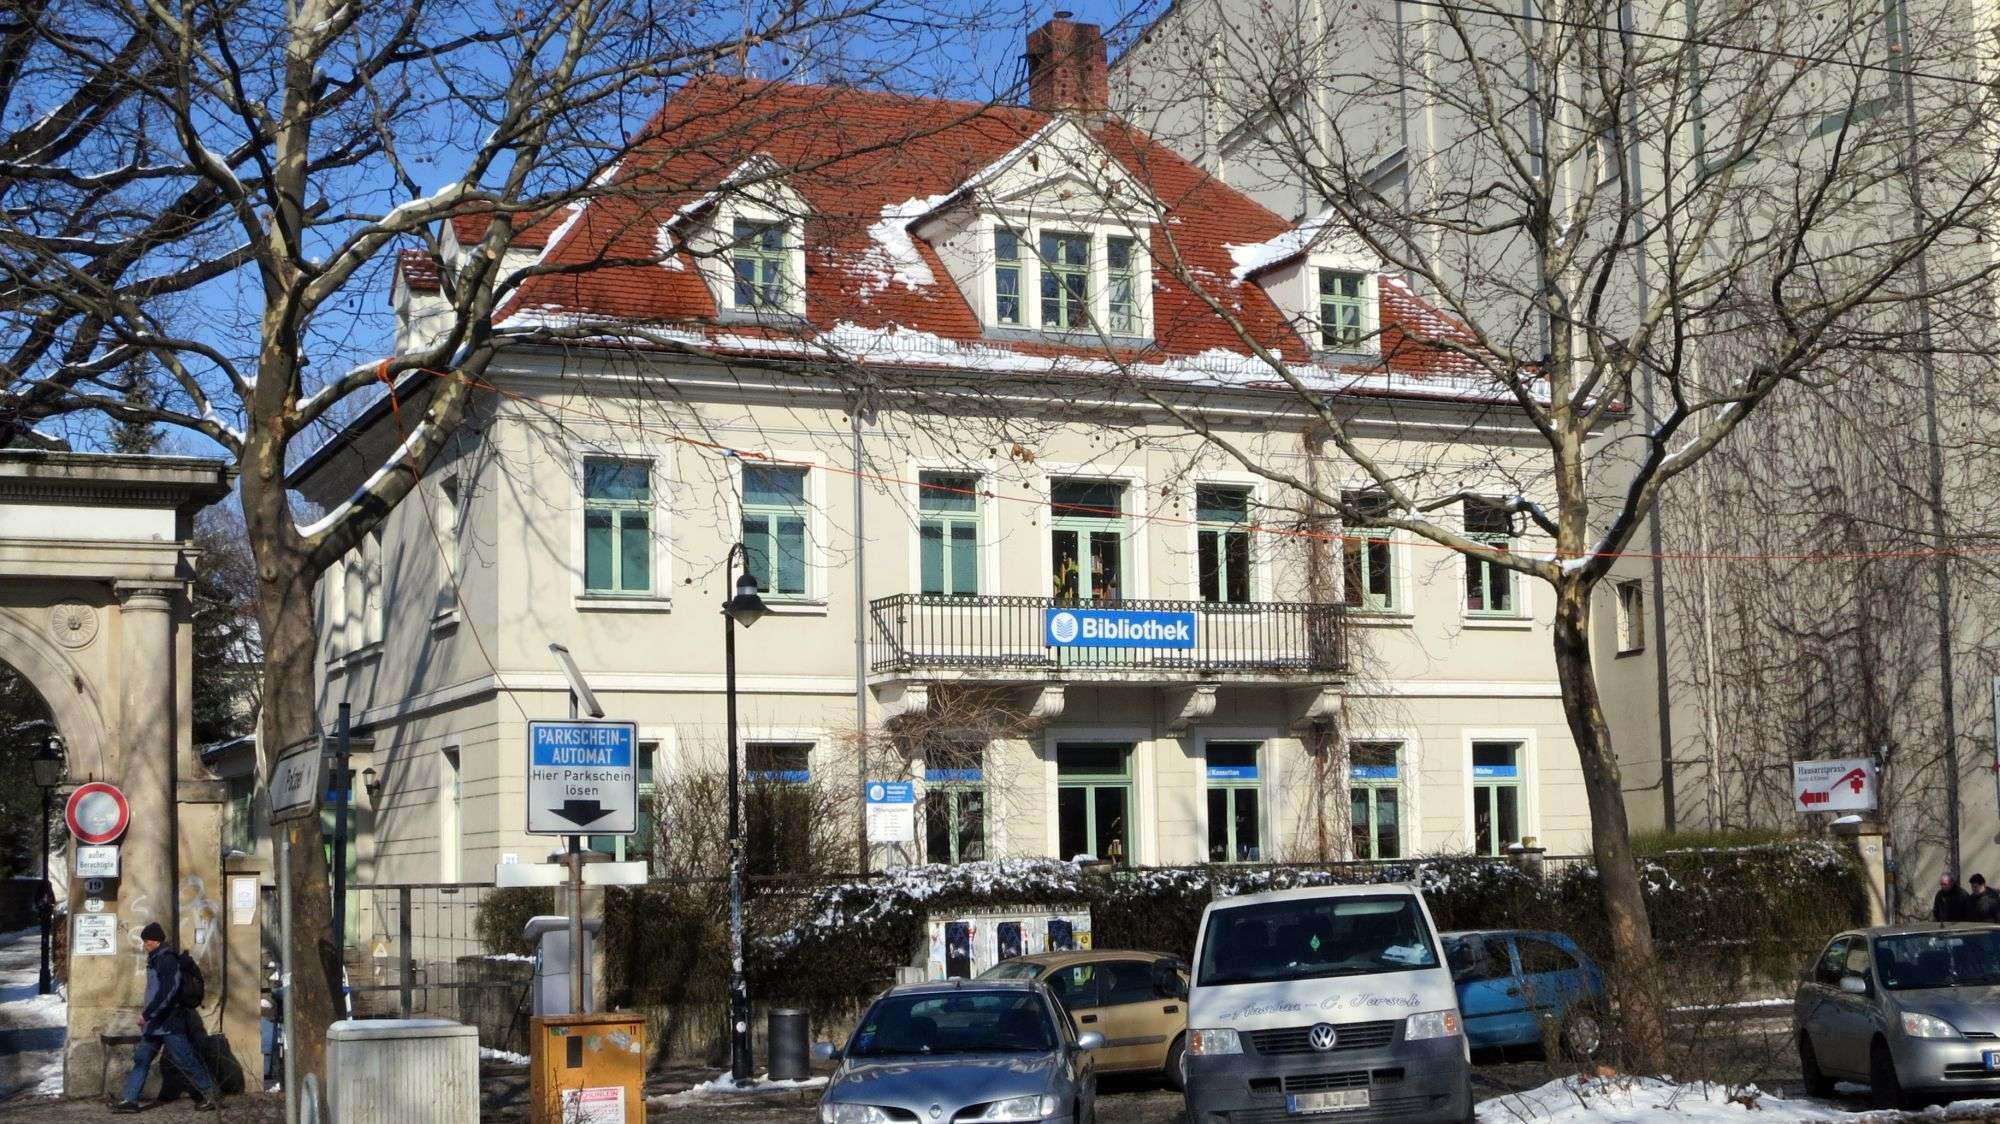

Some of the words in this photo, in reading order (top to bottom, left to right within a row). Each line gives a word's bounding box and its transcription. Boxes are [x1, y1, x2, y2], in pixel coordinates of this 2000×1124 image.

[1082, 617, 1189, 641] Bibliothek
[538, 728, 628, 745] PARKSCHEIN-
[552, 747, 613, 764] AUTOMAT
[533, 769, 558, 781] Hier
[564, 770, 631, 781] Parkschein
[566, 784, 599, 796] lösen
